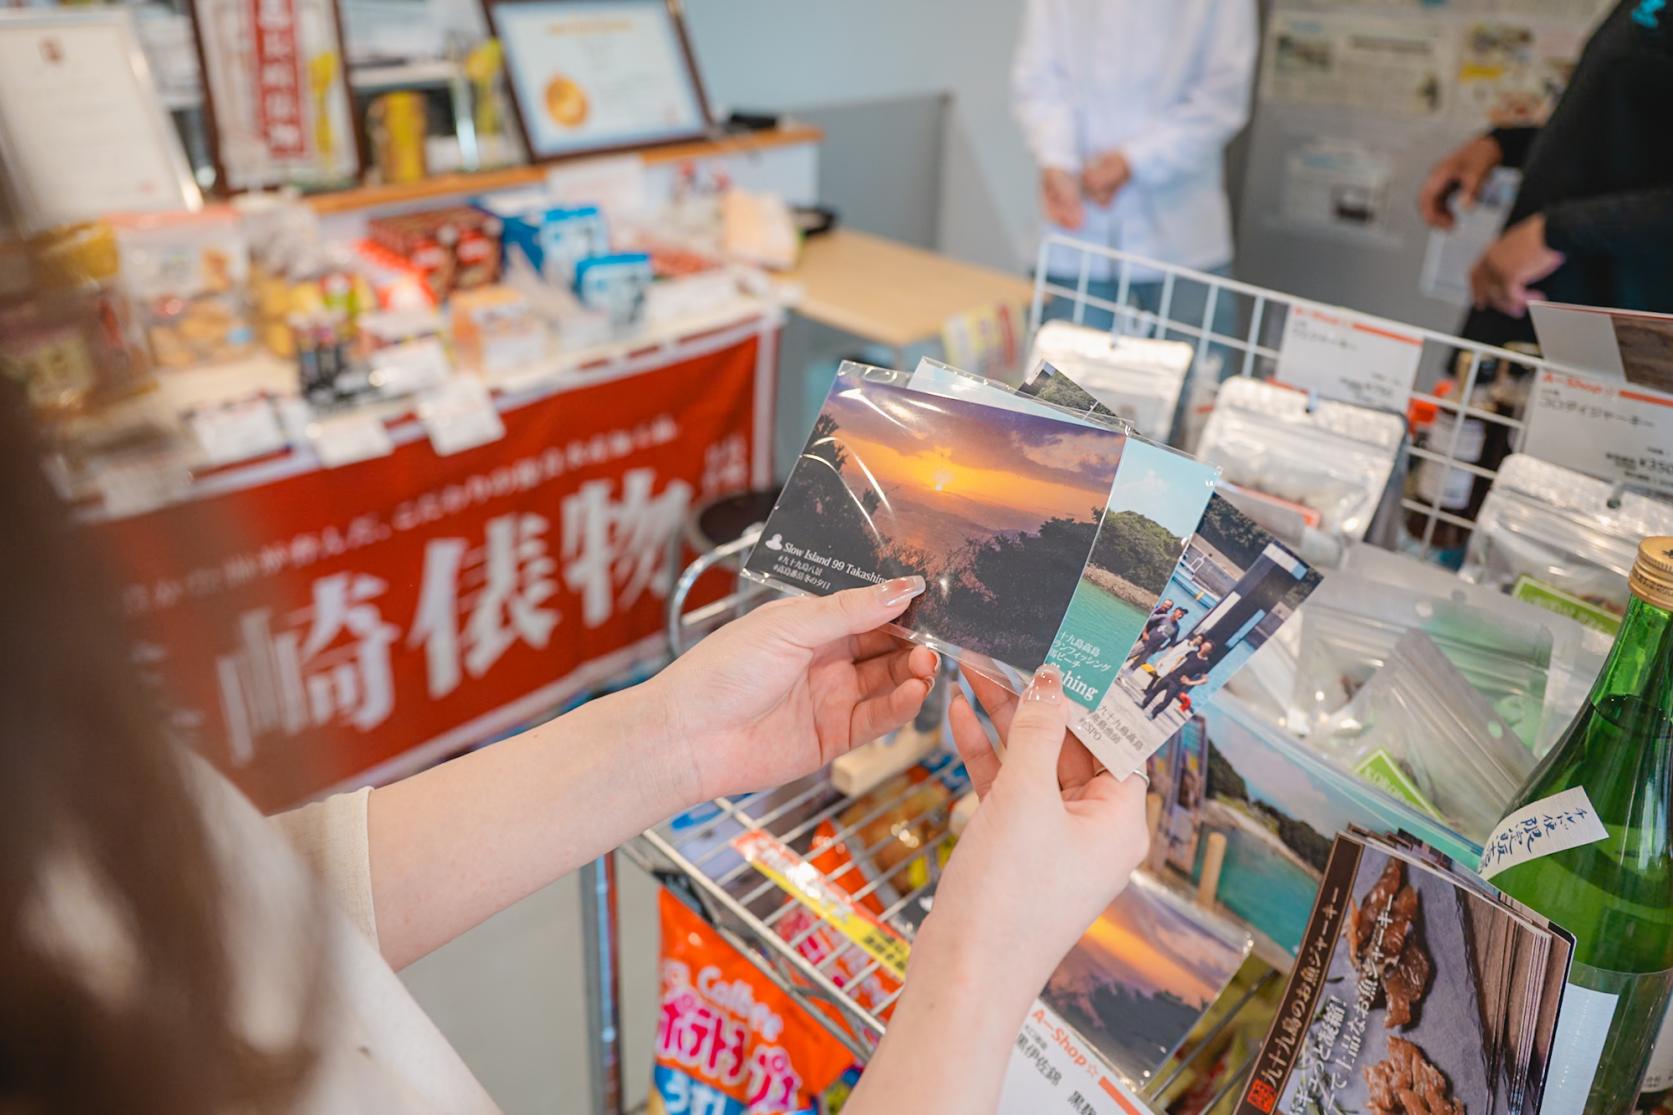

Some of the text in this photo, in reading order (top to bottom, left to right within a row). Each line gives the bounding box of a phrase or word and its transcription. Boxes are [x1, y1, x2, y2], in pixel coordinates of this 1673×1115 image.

[782, 542, 804, 557] Slow
[804, 550, 832, 567] Island
[831, 559, 846, 571] 99
[1263, 887, 1340, 1088] 九十九島のお魚ジャーキー
